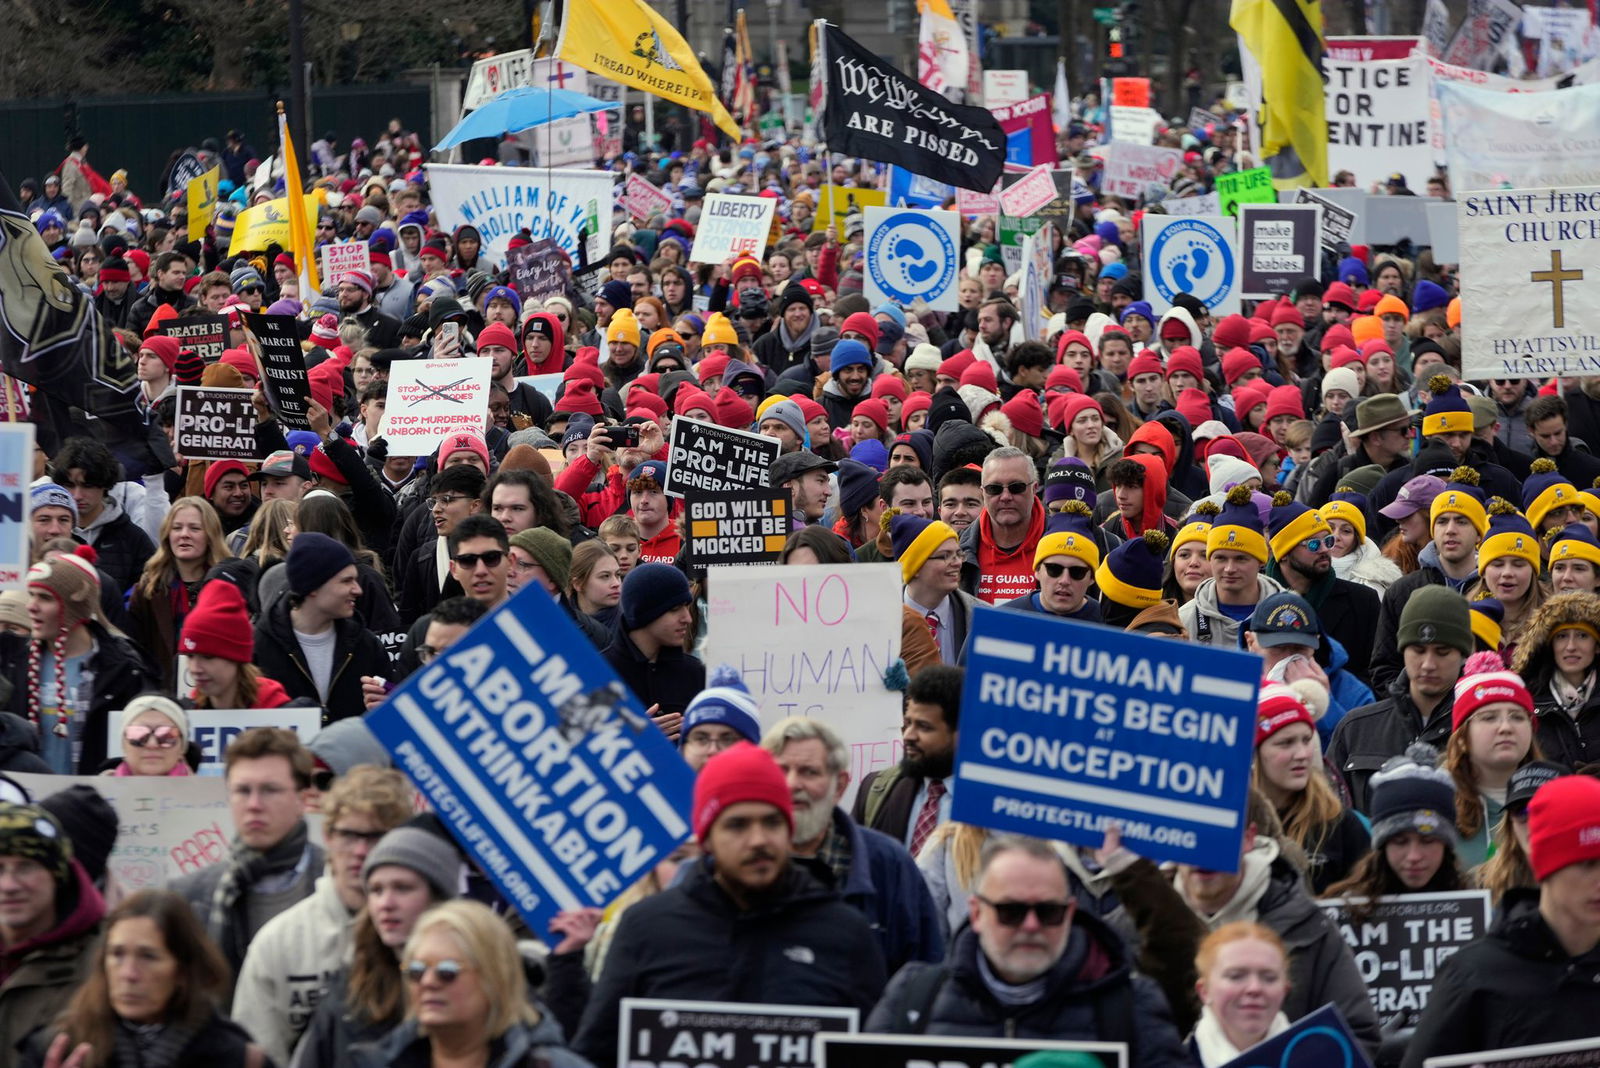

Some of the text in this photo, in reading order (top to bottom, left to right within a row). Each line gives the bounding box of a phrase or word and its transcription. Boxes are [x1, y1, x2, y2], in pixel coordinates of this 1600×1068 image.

[599, 55, 635, 76] TREAD
[636, 69, 682, 95] WHERE
[1325, 91, 1373, 117] OR
[846, 111, 895, 138] ARE
[903, 125, 980, 167] PISSED
[459, 185, 540, 224] WILLIAM
[547, 190, 568, 215] OF
[708, 199, 767, 220] LIBERTY
[1466, 195, 1537, 217] SAINT
[478, 212, 524, 256] HOLIC
[706, 218, 762, 236] STANDS
[1256, 222, 1292, 237] make
[328, 244, 364, 257] STOP
[701, 235, 759, 254] FOR LIFE
[1255, 240, 1290, 252] more
[1254, 256, 1304, 272] babies.
[166, 322, 224, 338] DEATH IS
[266, 322, 280, 331] WE
[186, 334, 225, 345] WELCOME
[259, 336, 295, 348] MARCH
[269, 353, 292, 363] WITH
[266, 366, 305, 380] CHRIST
[279, 386, 296, 395] FOR
[397, 384, 421, 393] STOP
[200, 400, 231, 415] AM
[390, 414, 482, 425] STOP MURDERING
[386, 426, 431, 437] UNBORN
[698, 427, 764, 449] STUDENTSFORLIFE.ORG
[455, 437, 471, 448] M
[693, 436, 724, 455] AM
[732, 444, 770, 466] THE
[672, 446, 771, 488] PRO-LIFE
[1048, 470, 1074, 481] HOLY
[671, 468, 756, 492] GENERA
[690, 499, 772, 520] GOD WILL
[718, 517, 786, 537] NOT BE
[692, 536, 764, 555] MOCKED
[641, 554, 675, 564] GUARD
[775, 573, 851, 627] NO
[741, 639, 892, 695] HUMAN
[1042, 641, 1185, 696] HUMAN
[979, 672, 1239, 747] RIGHTS BEGIN
[1094, 726, 1117, 742] AT
[445, 644, 658, 879] ABORTION
[980, 727, 1224, 800] CONCEPTION
[417, 665, 622, 905] UNTHINKABLE
[1340, 916, 1475, 947] AM THE
[637, 1028, 817, 1063] I AM TH
